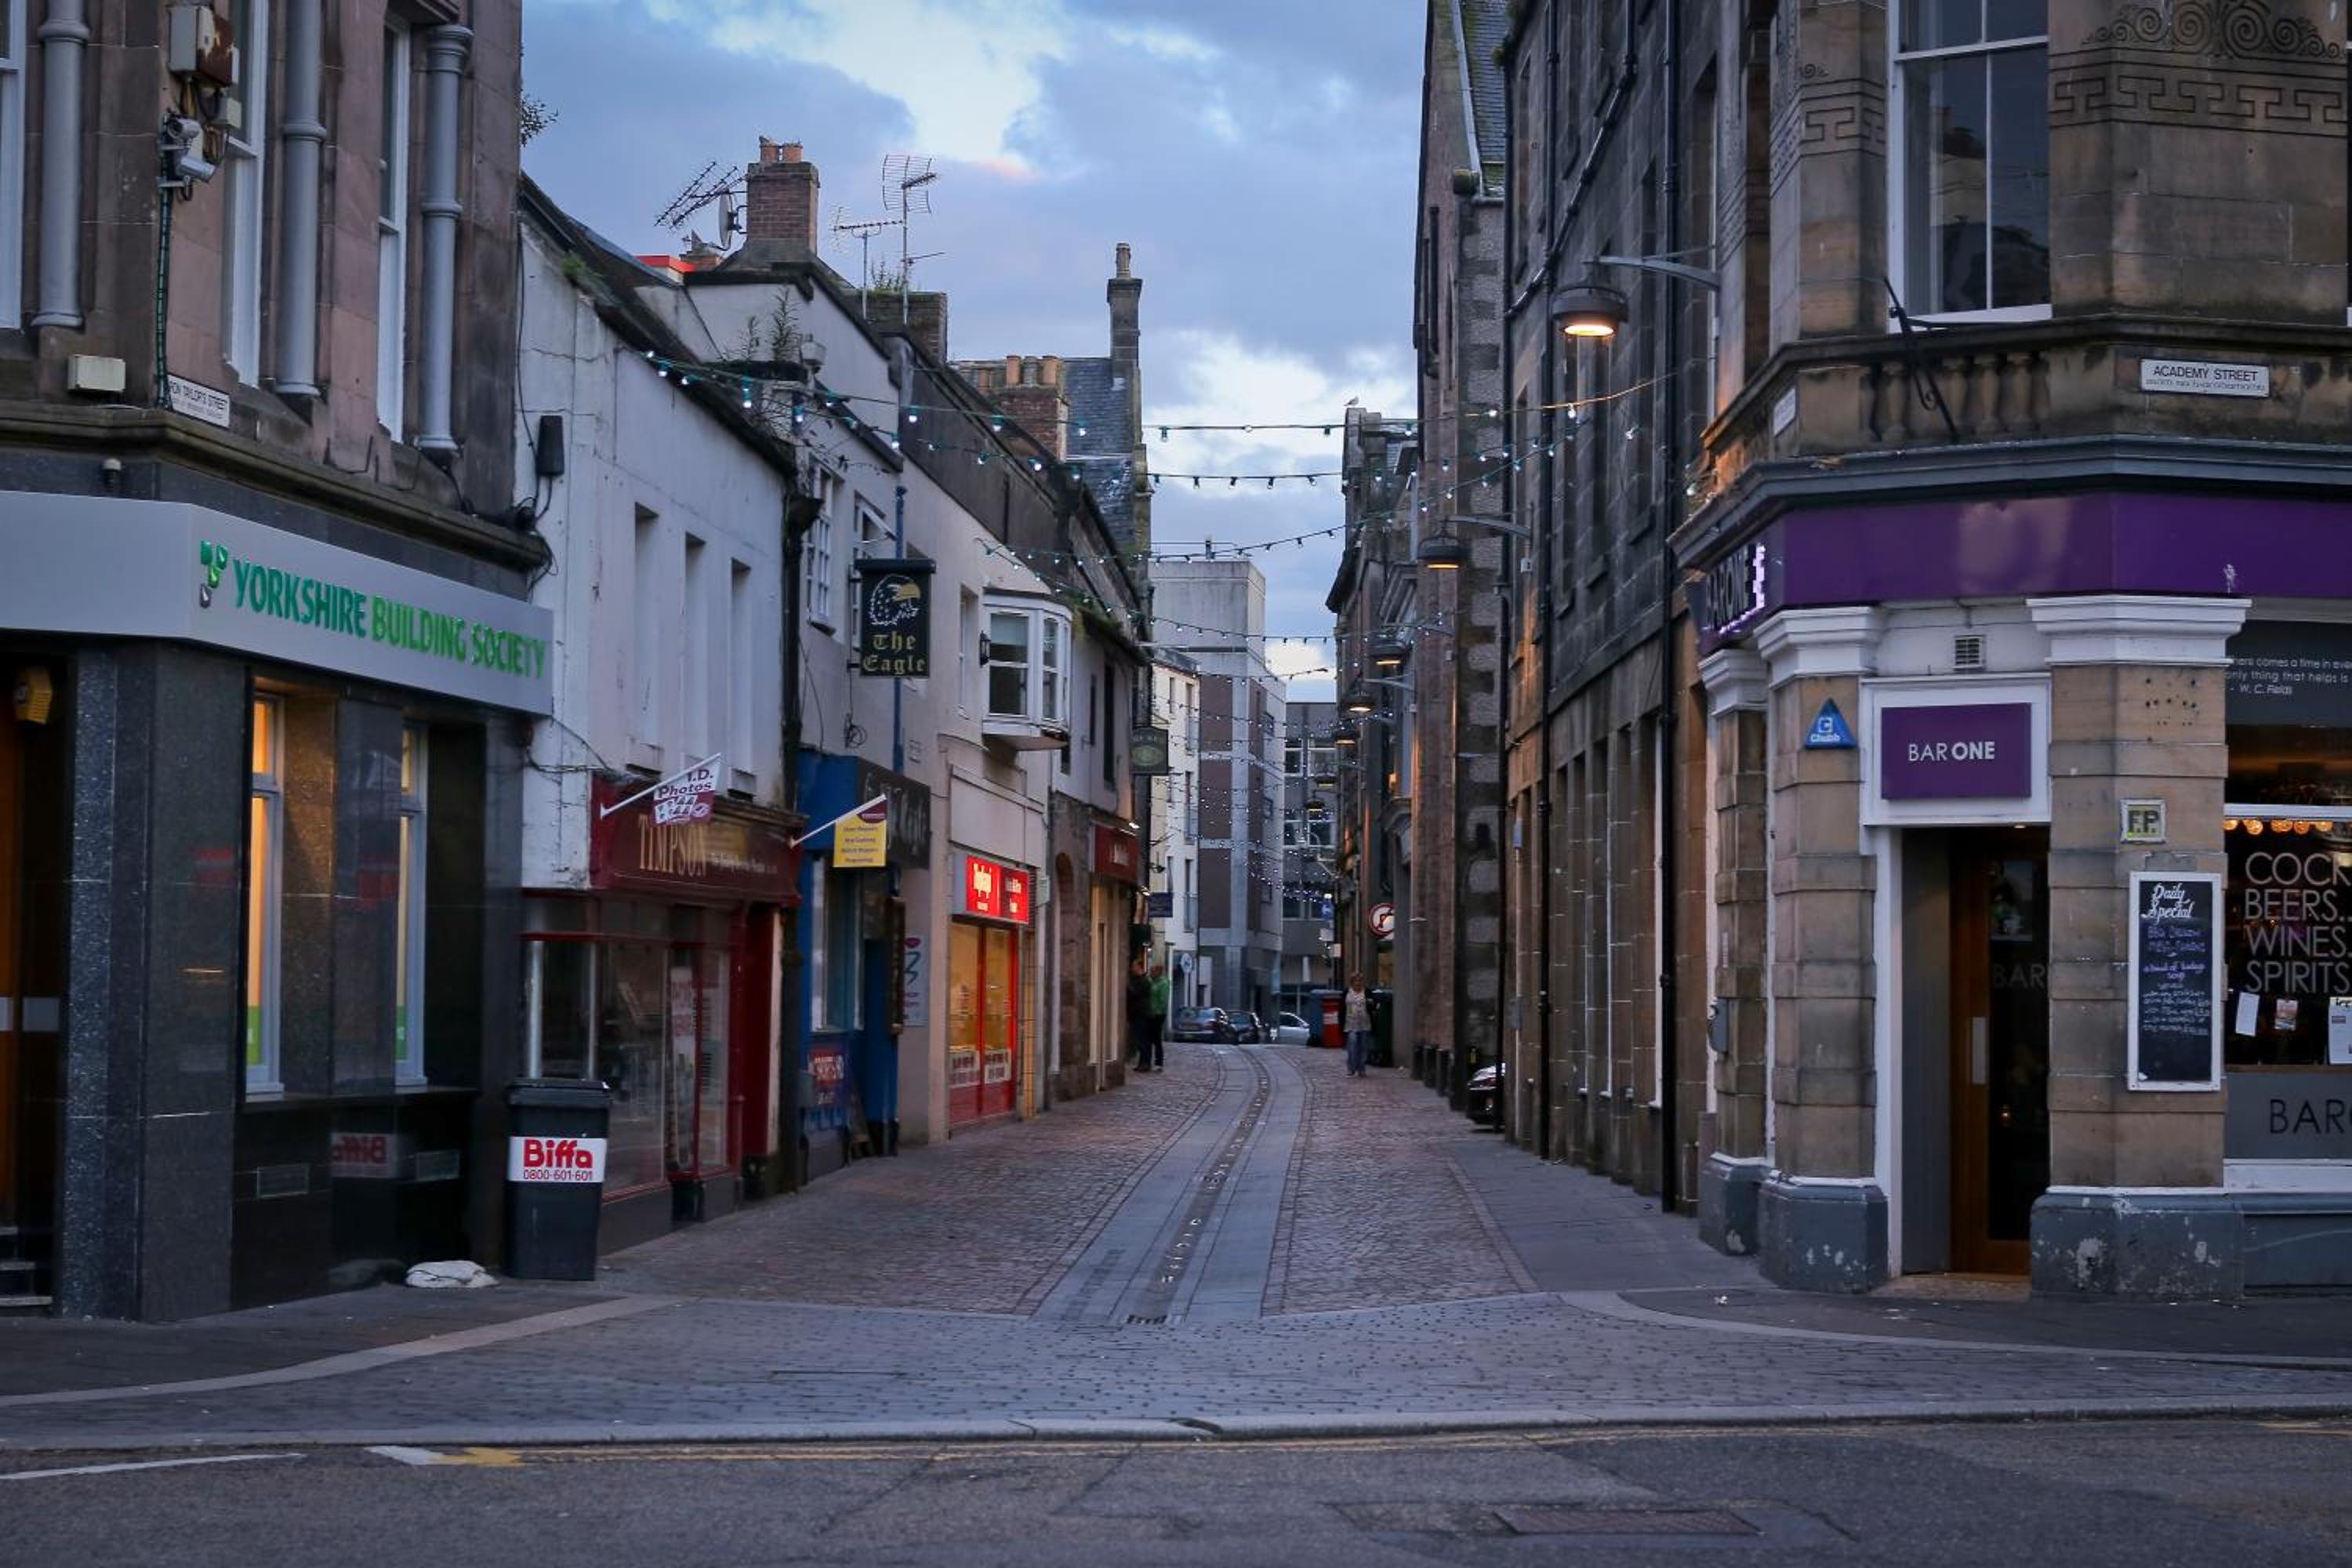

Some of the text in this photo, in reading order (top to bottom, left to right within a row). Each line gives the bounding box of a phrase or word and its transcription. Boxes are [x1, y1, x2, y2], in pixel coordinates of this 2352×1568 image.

[2153, 365, 2259, 382] ACADEMY STREET
[232, 557, 547, 680] YORKSHIRE BUILDING SOCIETY
[873, 630, 916, 652] The
[863, 654, 926, 675] Eagle
[2251, 670, 2279, 682] thing
[2282, 671, 2305, 681] that
[1809, 732, 1842, 743] Chubb
[1907, 740, 1995, 762] BAR ONE
[686, 768, 714, 783] I.D.
[658, 781, 713, 799] Photos
[637, 812, 706, 877] TIMPSON
[2152, 882, 2185, 902] Daily
[2146, 899, 2195, 925] Special
[1993, 964, 2046, 989] BAR
[2245, 960, 2351, 994] SPIRITS
[523, 1138, 593, 1168] Biffa
